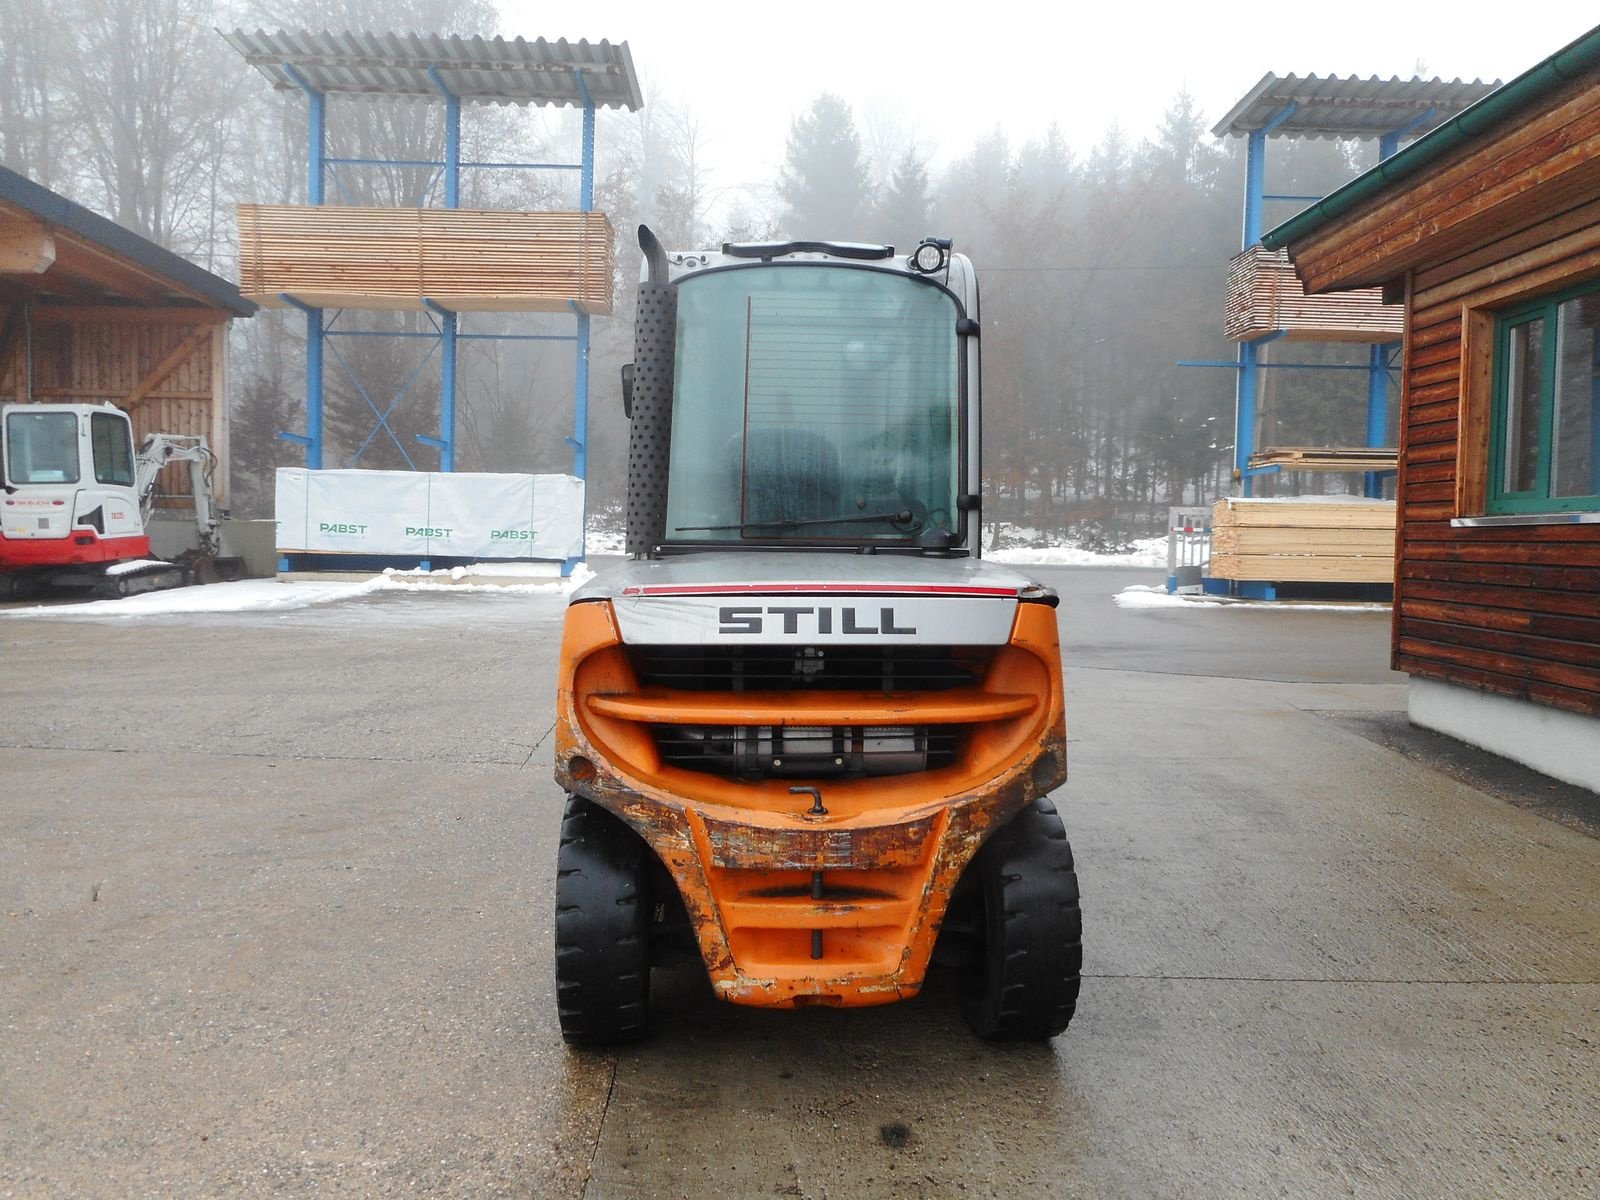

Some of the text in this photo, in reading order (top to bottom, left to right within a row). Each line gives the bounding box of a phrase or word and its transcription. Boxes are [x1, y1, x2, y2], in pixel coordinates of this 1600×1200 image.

[319, 523, 367, 534] PABST
[405, 526, 453, 538] PABST
[490, 530, 538, 540] PABST
[719, 607, 916, 635] STILL
